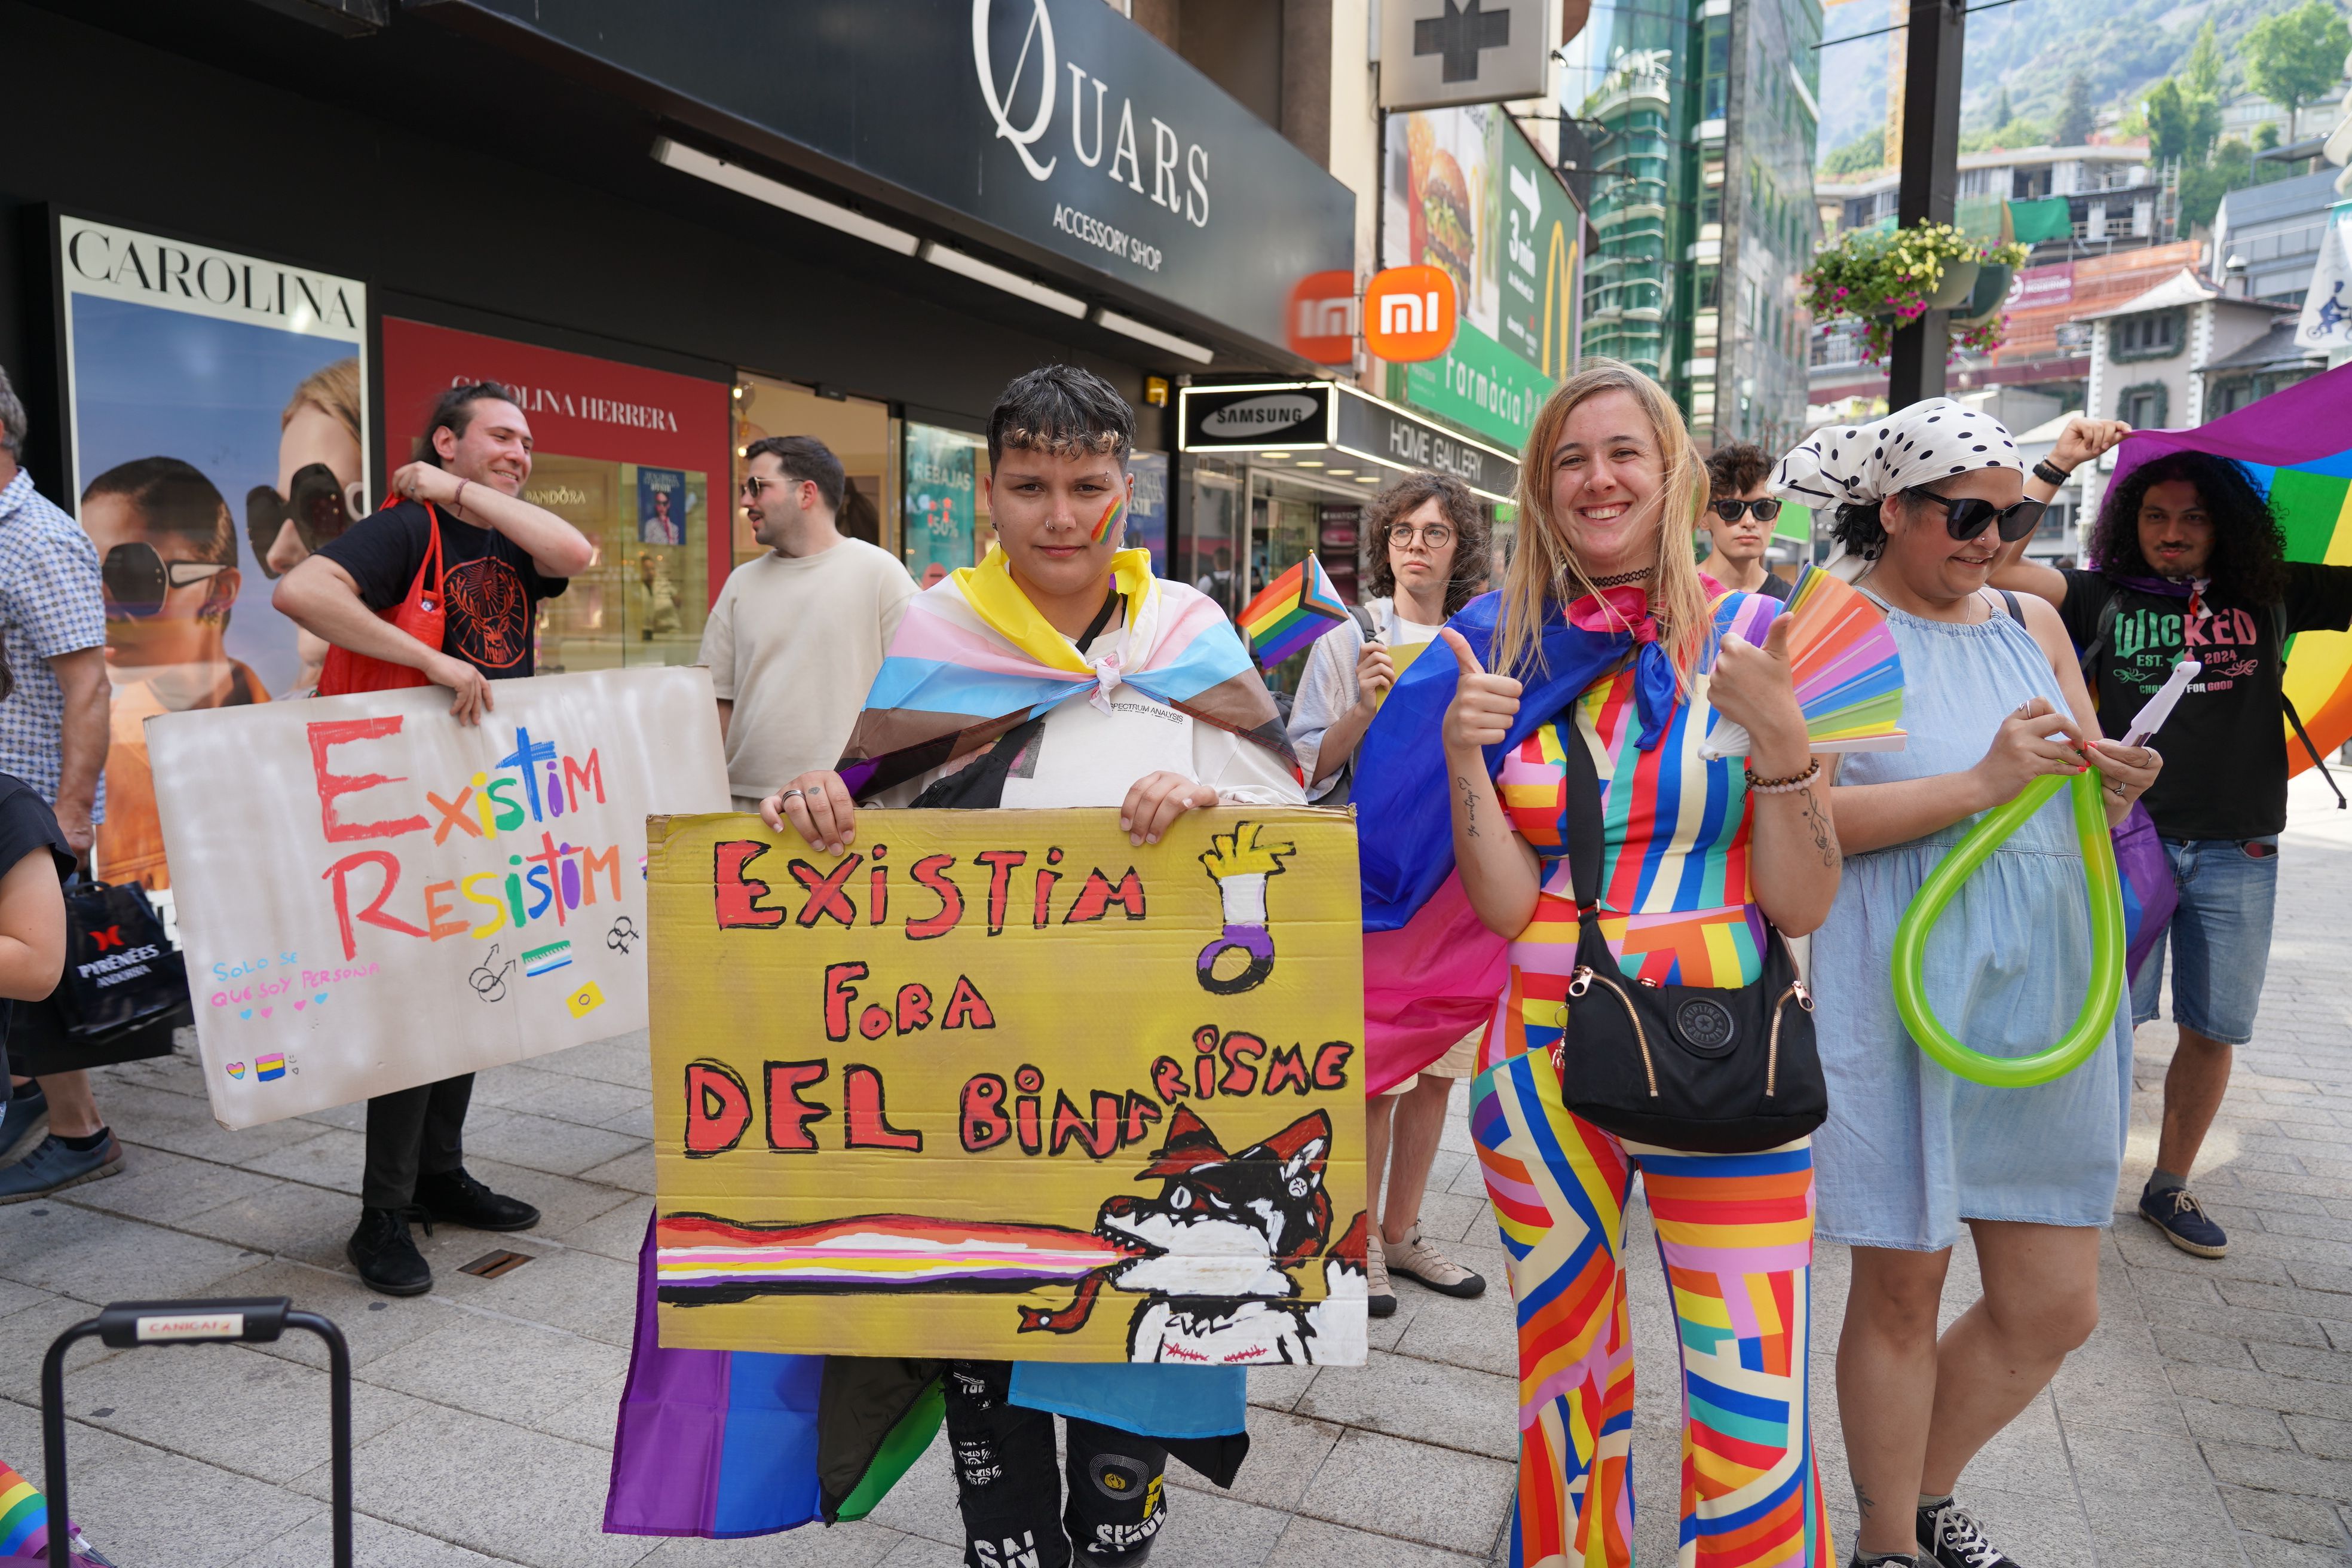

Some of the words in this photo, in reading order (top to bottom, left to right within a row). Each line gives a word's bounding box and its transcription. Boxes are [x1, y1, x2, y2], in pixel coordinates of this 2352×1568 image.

[972, 0, 1209, 228] QUARS
[1053, 202, 1129, 258] ACCESSORY
[1130, 237, 1162, 272] SHOP
[1508, 209, 1520, 262] 3
[69, 229, 357, 329] CAROLINA
[580, 396, 678, 433] HERRERA
[1217, 408, 1303, 424] SAMSUNG
[1389, 419, 1430, 465] HOME
[1434, 438, 1484, 482] GALLERY
[914, 462, 971, 492] REBAJAS
[2114, 608, 2257, 659] WICKED
[2136, 654, 2163, 667] EST.
[2204, 649, 2238, 664] 2024
[2186, 682, 2206, 694] FOR
[2207, 680, 2233, 691] GOOD
[1150, 708, 1183, 722] ANALYSIS
[258, 977, 292, 999] SOY
[302, 962, 379, 989] PERSONA
[1685, 1005, 1720, 1020] KIPLING
[683, 1056, 923, 1159] DEL
